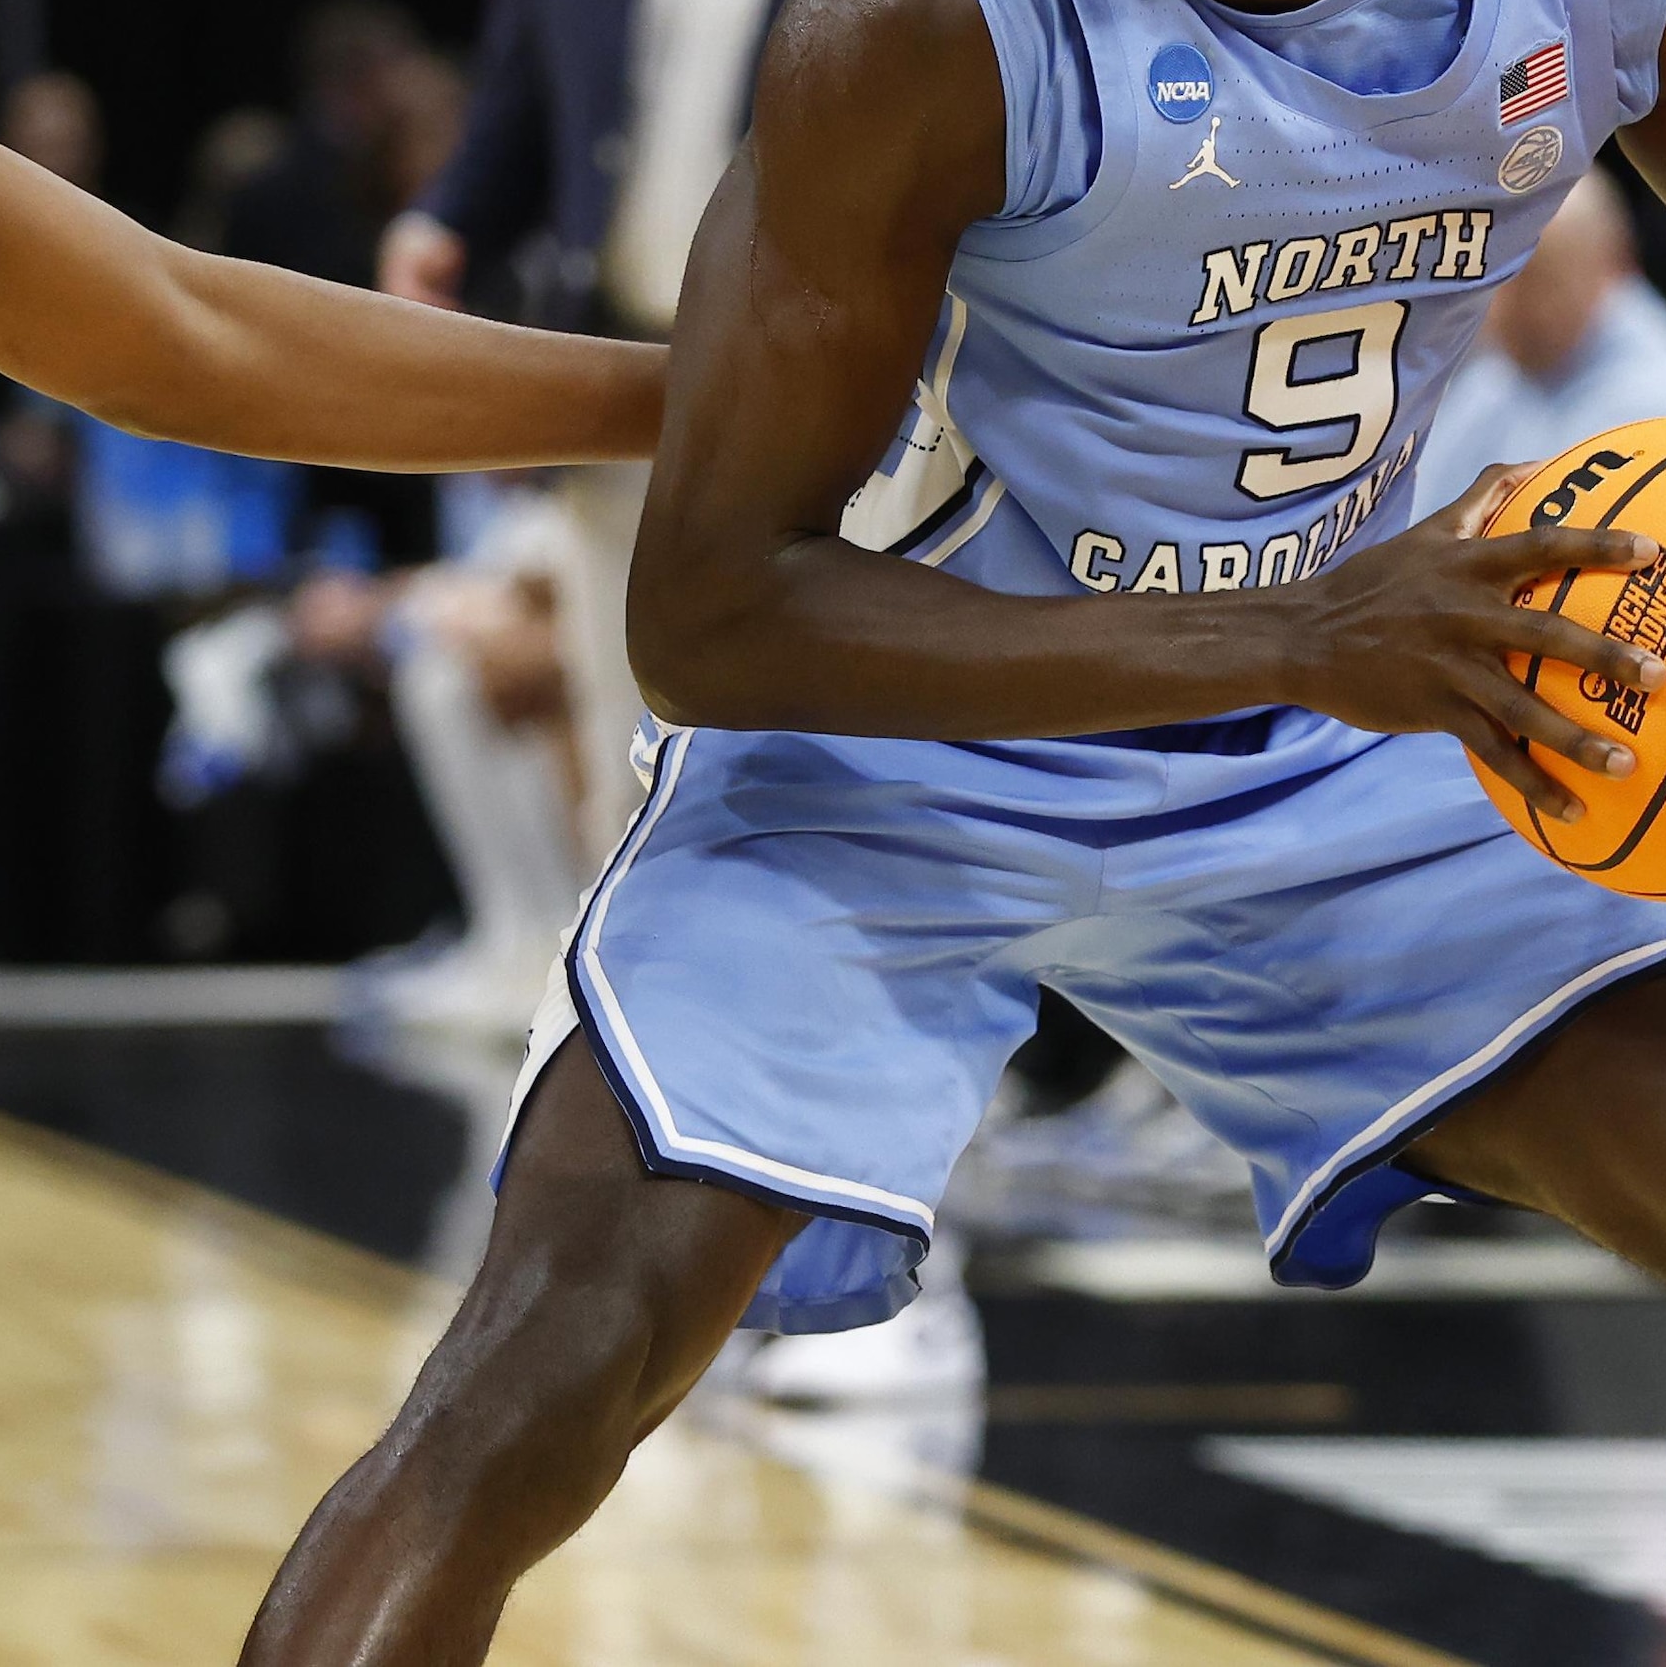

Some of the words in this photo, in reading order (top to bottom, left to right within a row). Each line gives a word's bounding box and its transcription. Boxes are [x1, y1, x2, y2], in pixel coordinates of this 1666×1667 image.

[1156, 80, 1211, 103] NCAA
[1187, 208, 1494, 327] NORTH
[1233, 298, 1411, 502] 9
